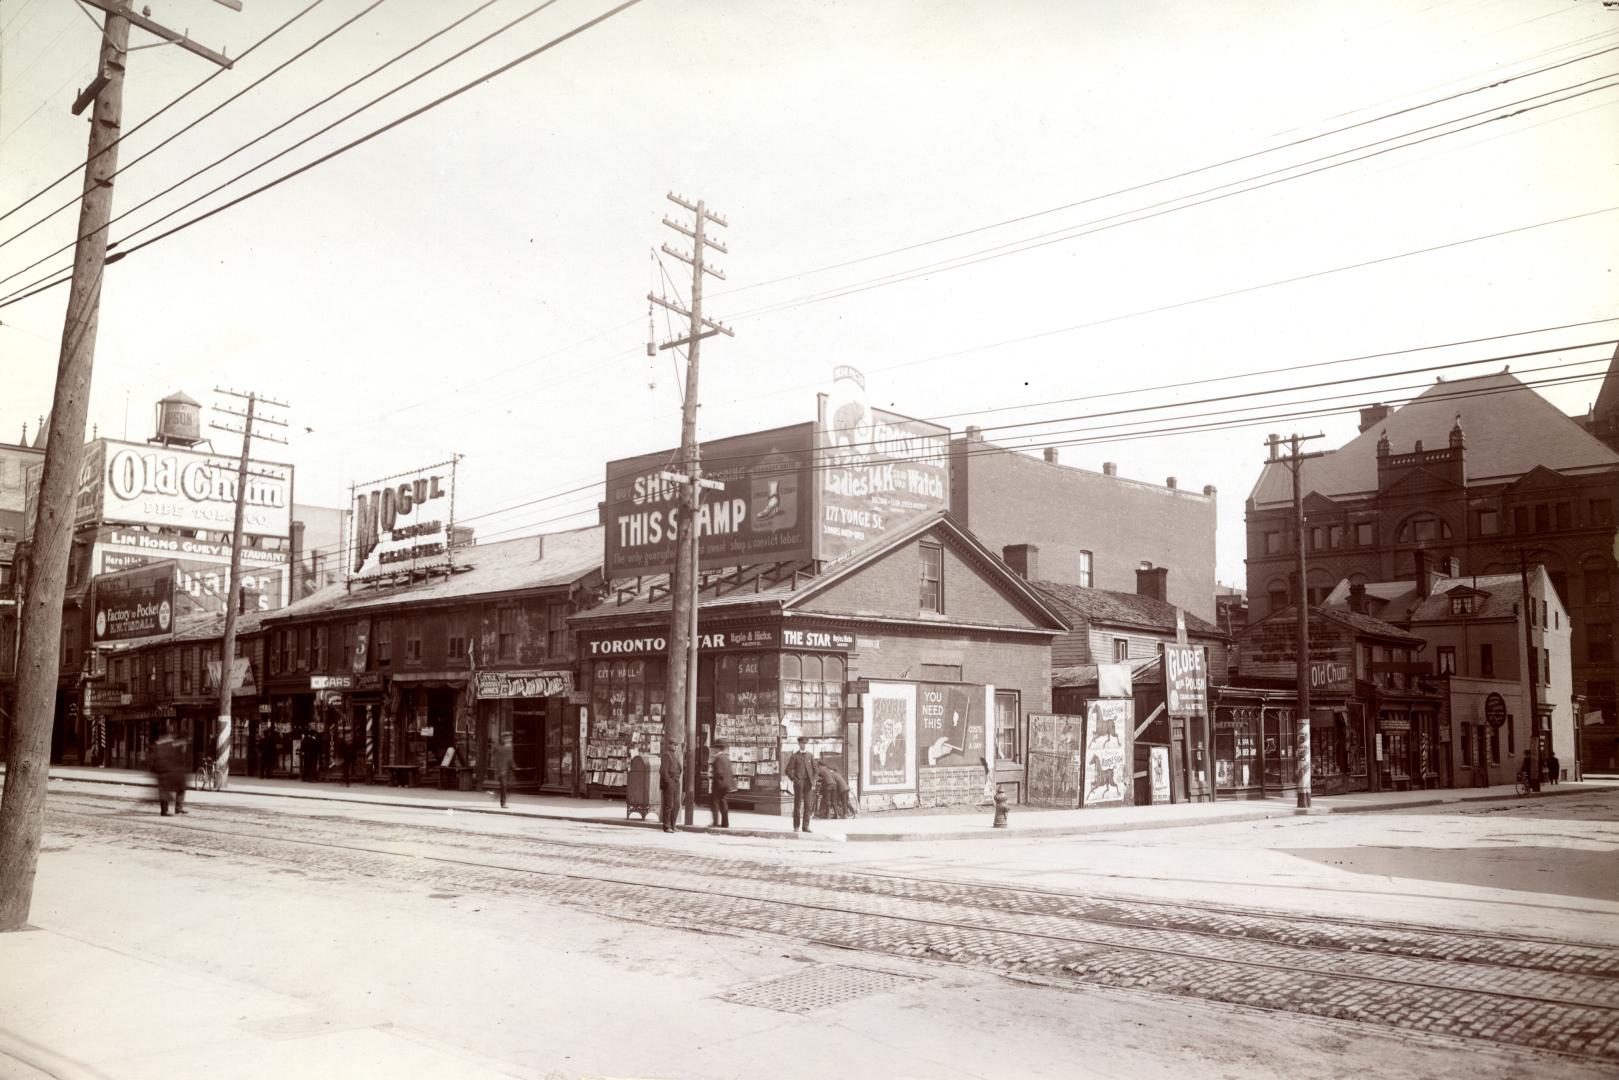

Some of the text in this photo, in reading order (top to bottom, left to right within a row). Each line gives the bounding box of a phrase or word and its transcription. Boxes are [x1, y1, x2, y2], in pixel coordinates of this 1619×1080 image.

[109, 449, 178, 501] Old
[825, 455, 869, 497] Ladies
[907, 468, 943, 500] Watch
[354, 476, 445, 573] MOGUL
[618, 498, 746, 547] THIS SAMP
[826, 505, 840, 522] 177
[840, 507, 871, 528] YONGE
[111, 532, 136, 546] LIN
[139, 536, 178, 551] HONG
[182, 541, 219, 556] GUEY
[107, 608, 131, 622] Factory
[137, 602, 159, 618] Pocket
[590, 637, 666, 654] TORONTO
[783, 630, 804, 646] THE
[806, 632, 832, 647] STAR
[598, 668, 636, 679] CITY HALL
[1185, 676, 1205, 690] POLISH
[1311, 663, 1348, 687] Old Chum
[924, 691, 943, 702] YOU
[922, 705, 944, 716] NEED
[924, 718, 943, 729] THIS
